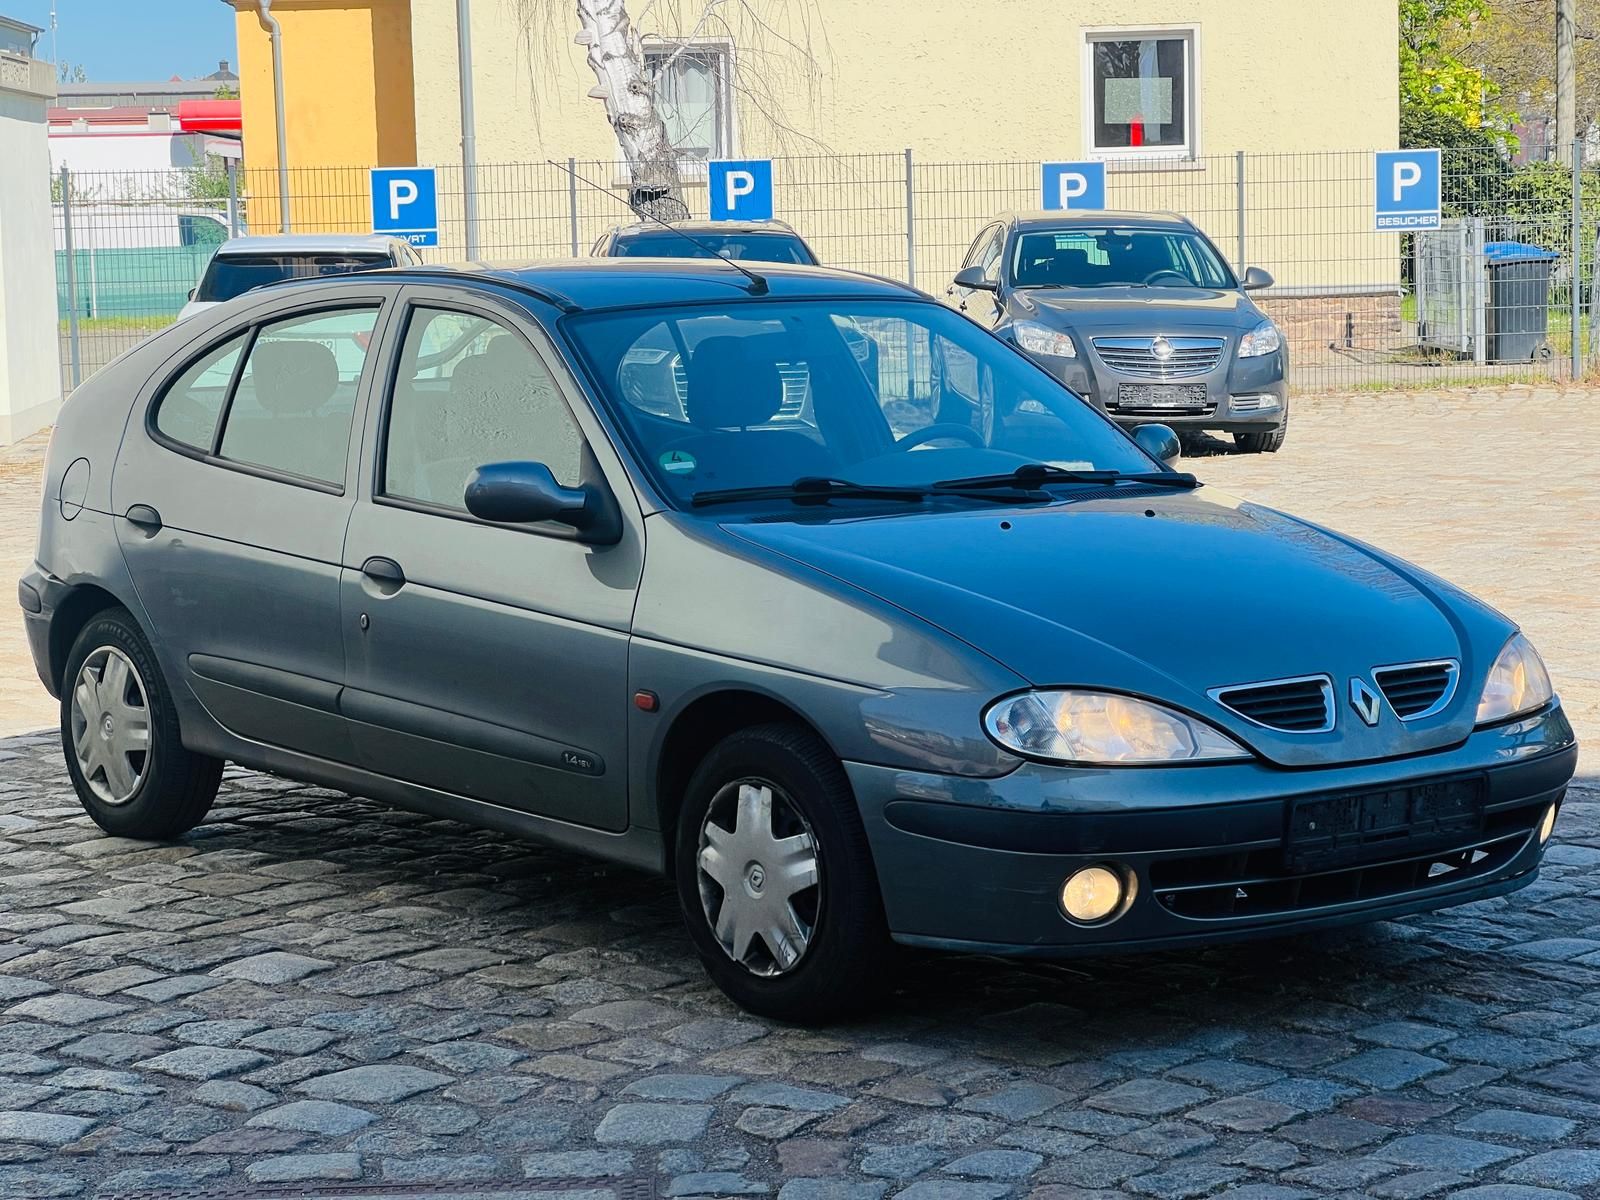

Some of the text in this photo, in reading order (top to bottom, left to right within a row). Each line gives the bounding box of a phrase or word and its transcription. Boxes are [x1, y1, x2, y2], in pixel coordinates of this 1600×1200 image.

[389, 179, 418, 220] P
[726, 170, 755, 210] P
[1059, 172, 1087, 210] P
[1393, 161, 1421, 202] P
[1377, 215, 1437, 226] BESUCHER
